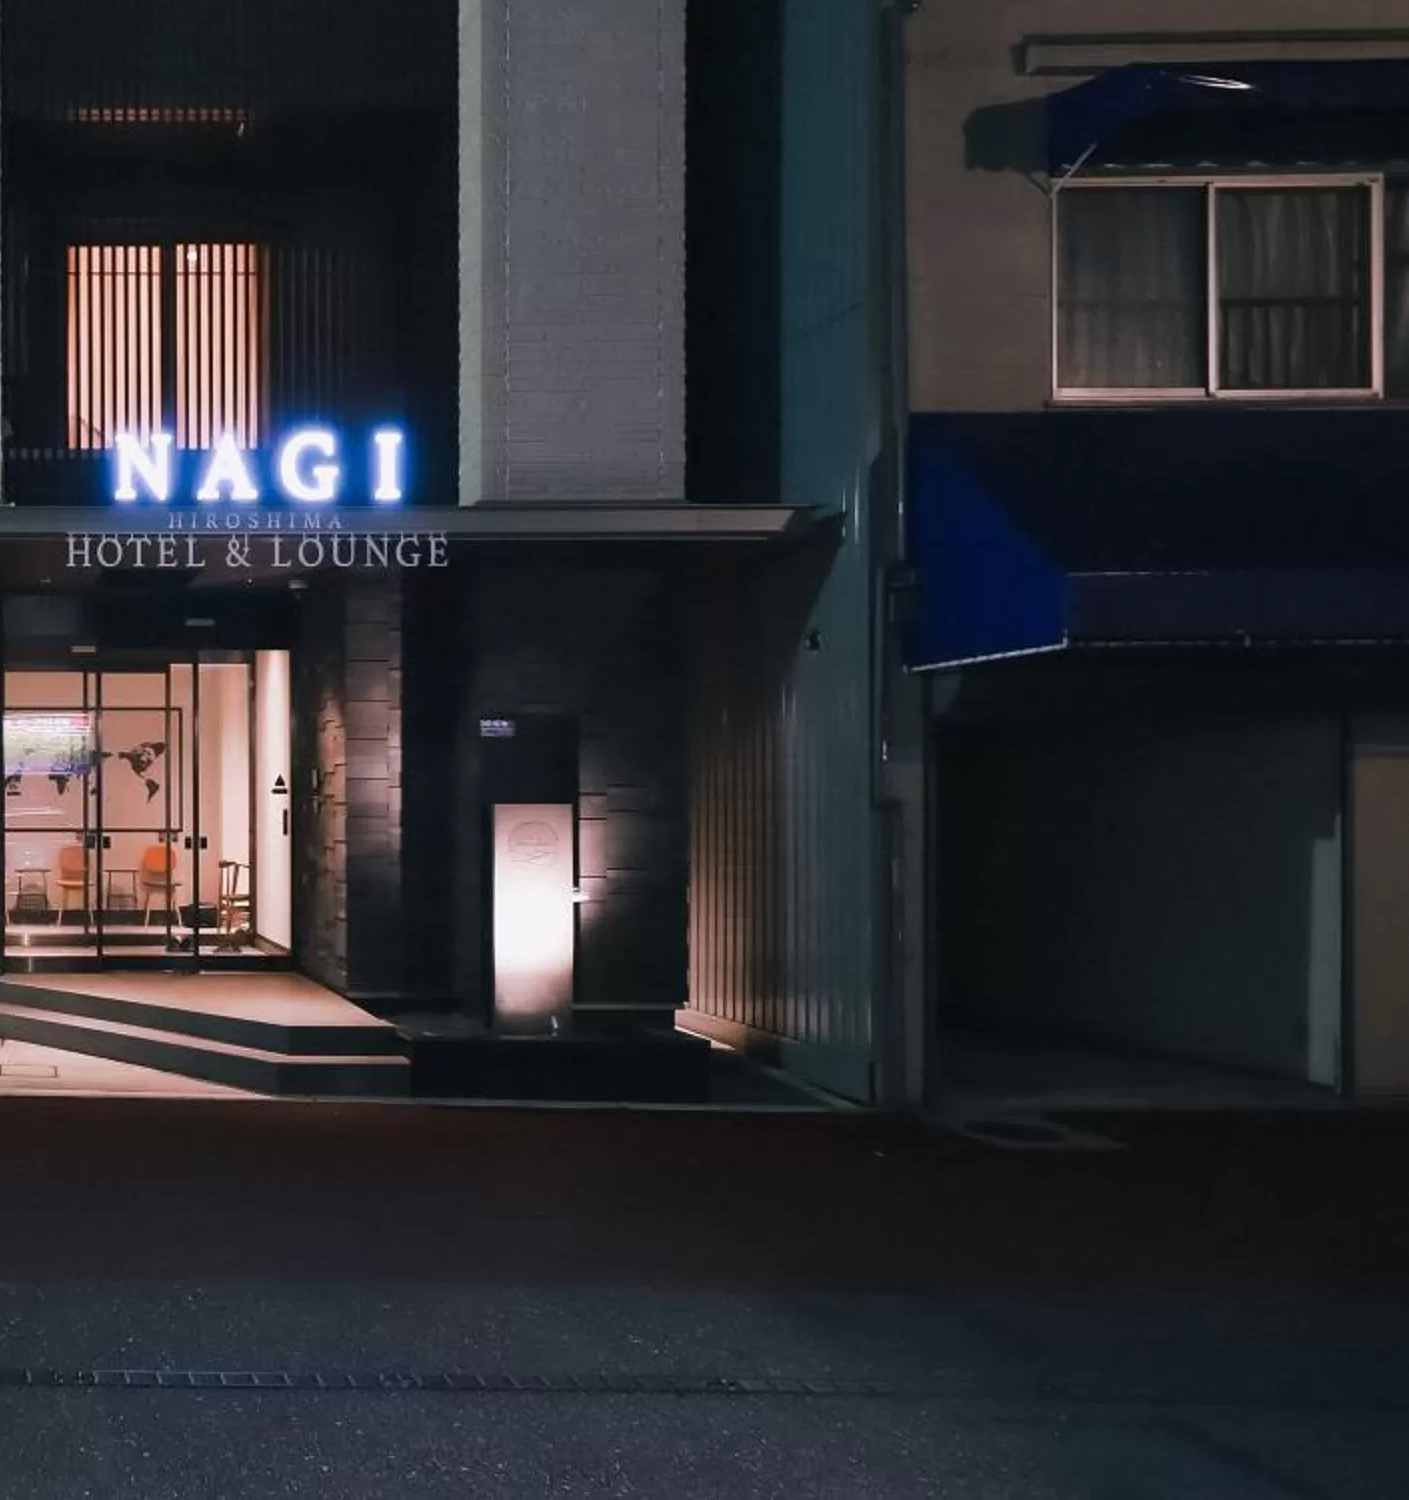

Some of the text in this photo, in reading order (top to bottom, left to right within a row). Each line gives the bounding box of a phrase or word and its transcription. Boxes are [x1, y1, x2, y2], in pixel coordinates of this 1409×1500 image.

[114, 431, 403, 501] NAGI
[168, 512, 343, 529] HIROSHIMA
[65, 535, 449, 567] HOTEL & LOUNGE
